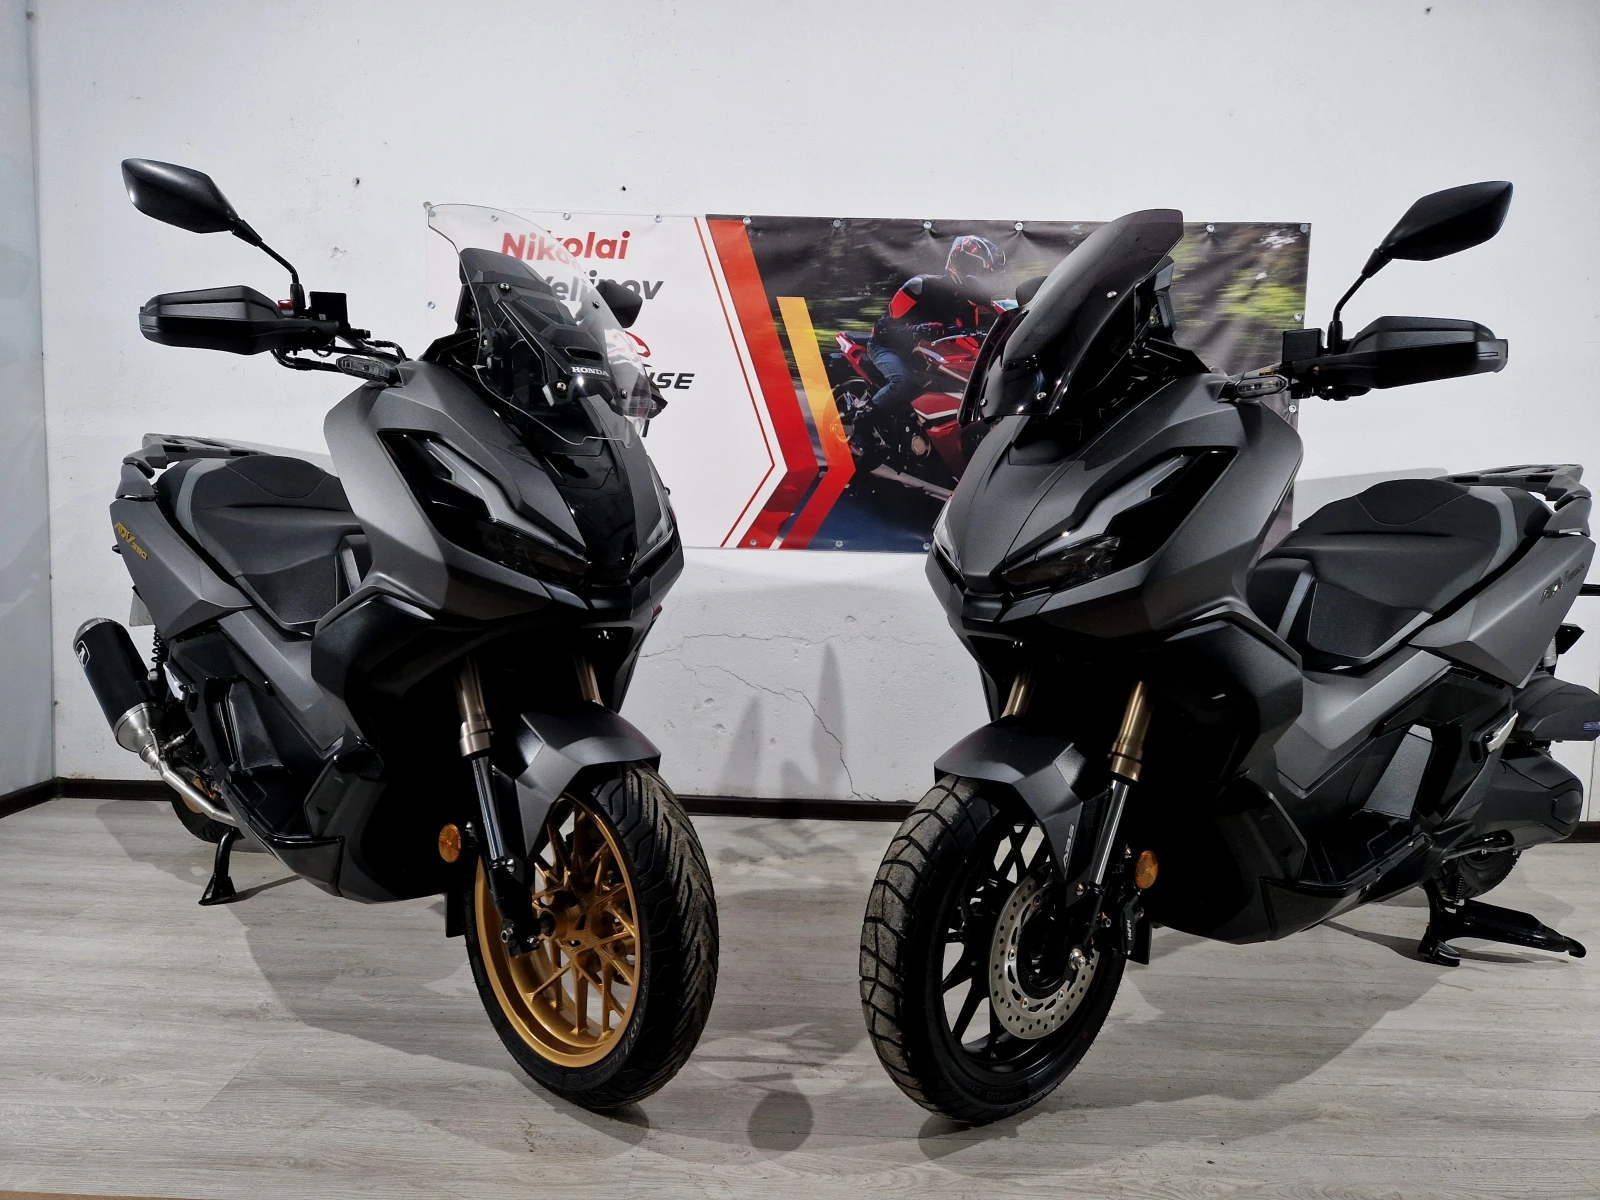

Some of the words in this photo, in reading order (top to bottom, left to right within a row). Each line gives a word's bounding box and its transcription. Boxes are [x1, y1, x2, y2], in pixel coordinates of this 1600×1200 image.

[502, 230, 631, 261] Nikolai
[544, 269, 664, 302] eliov
[571, 366, 610, 377] HONDA
[1063, 823, 1075, 869] ABS
